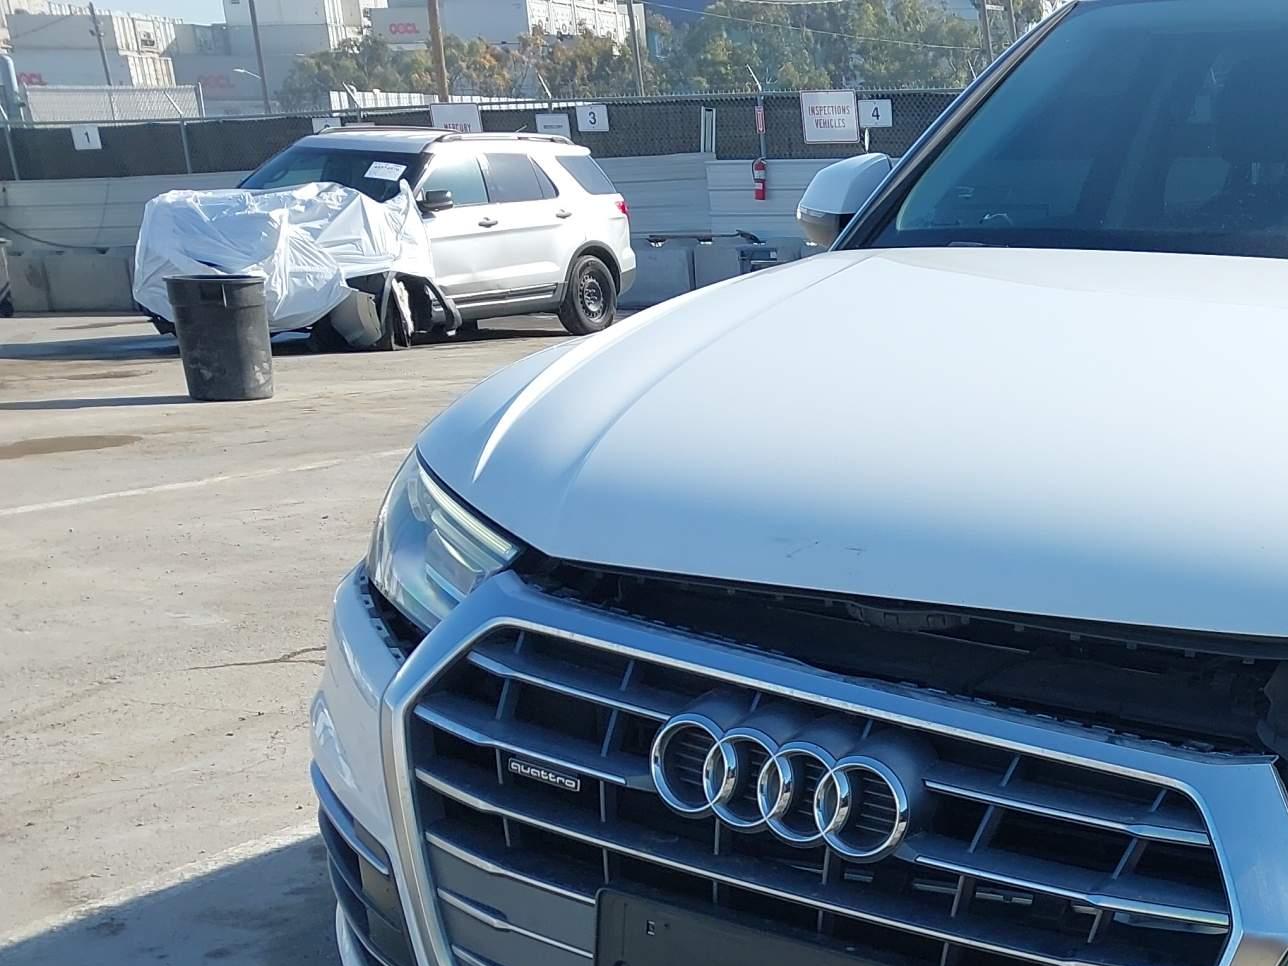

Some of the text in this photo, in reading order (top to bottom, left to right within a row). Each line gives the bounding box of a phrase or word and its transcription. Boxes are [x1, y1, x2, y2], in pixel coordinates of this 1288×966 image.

[808, 105, 850, 116] INSPECTIONS
[871, 106, 880, 121] 4
[588, 111, 597, 125] 3
[814, 118, 846, 129] VEHICLES
[84, 131, 90, 144] 1
[510, 761, 576, 788] quattro
